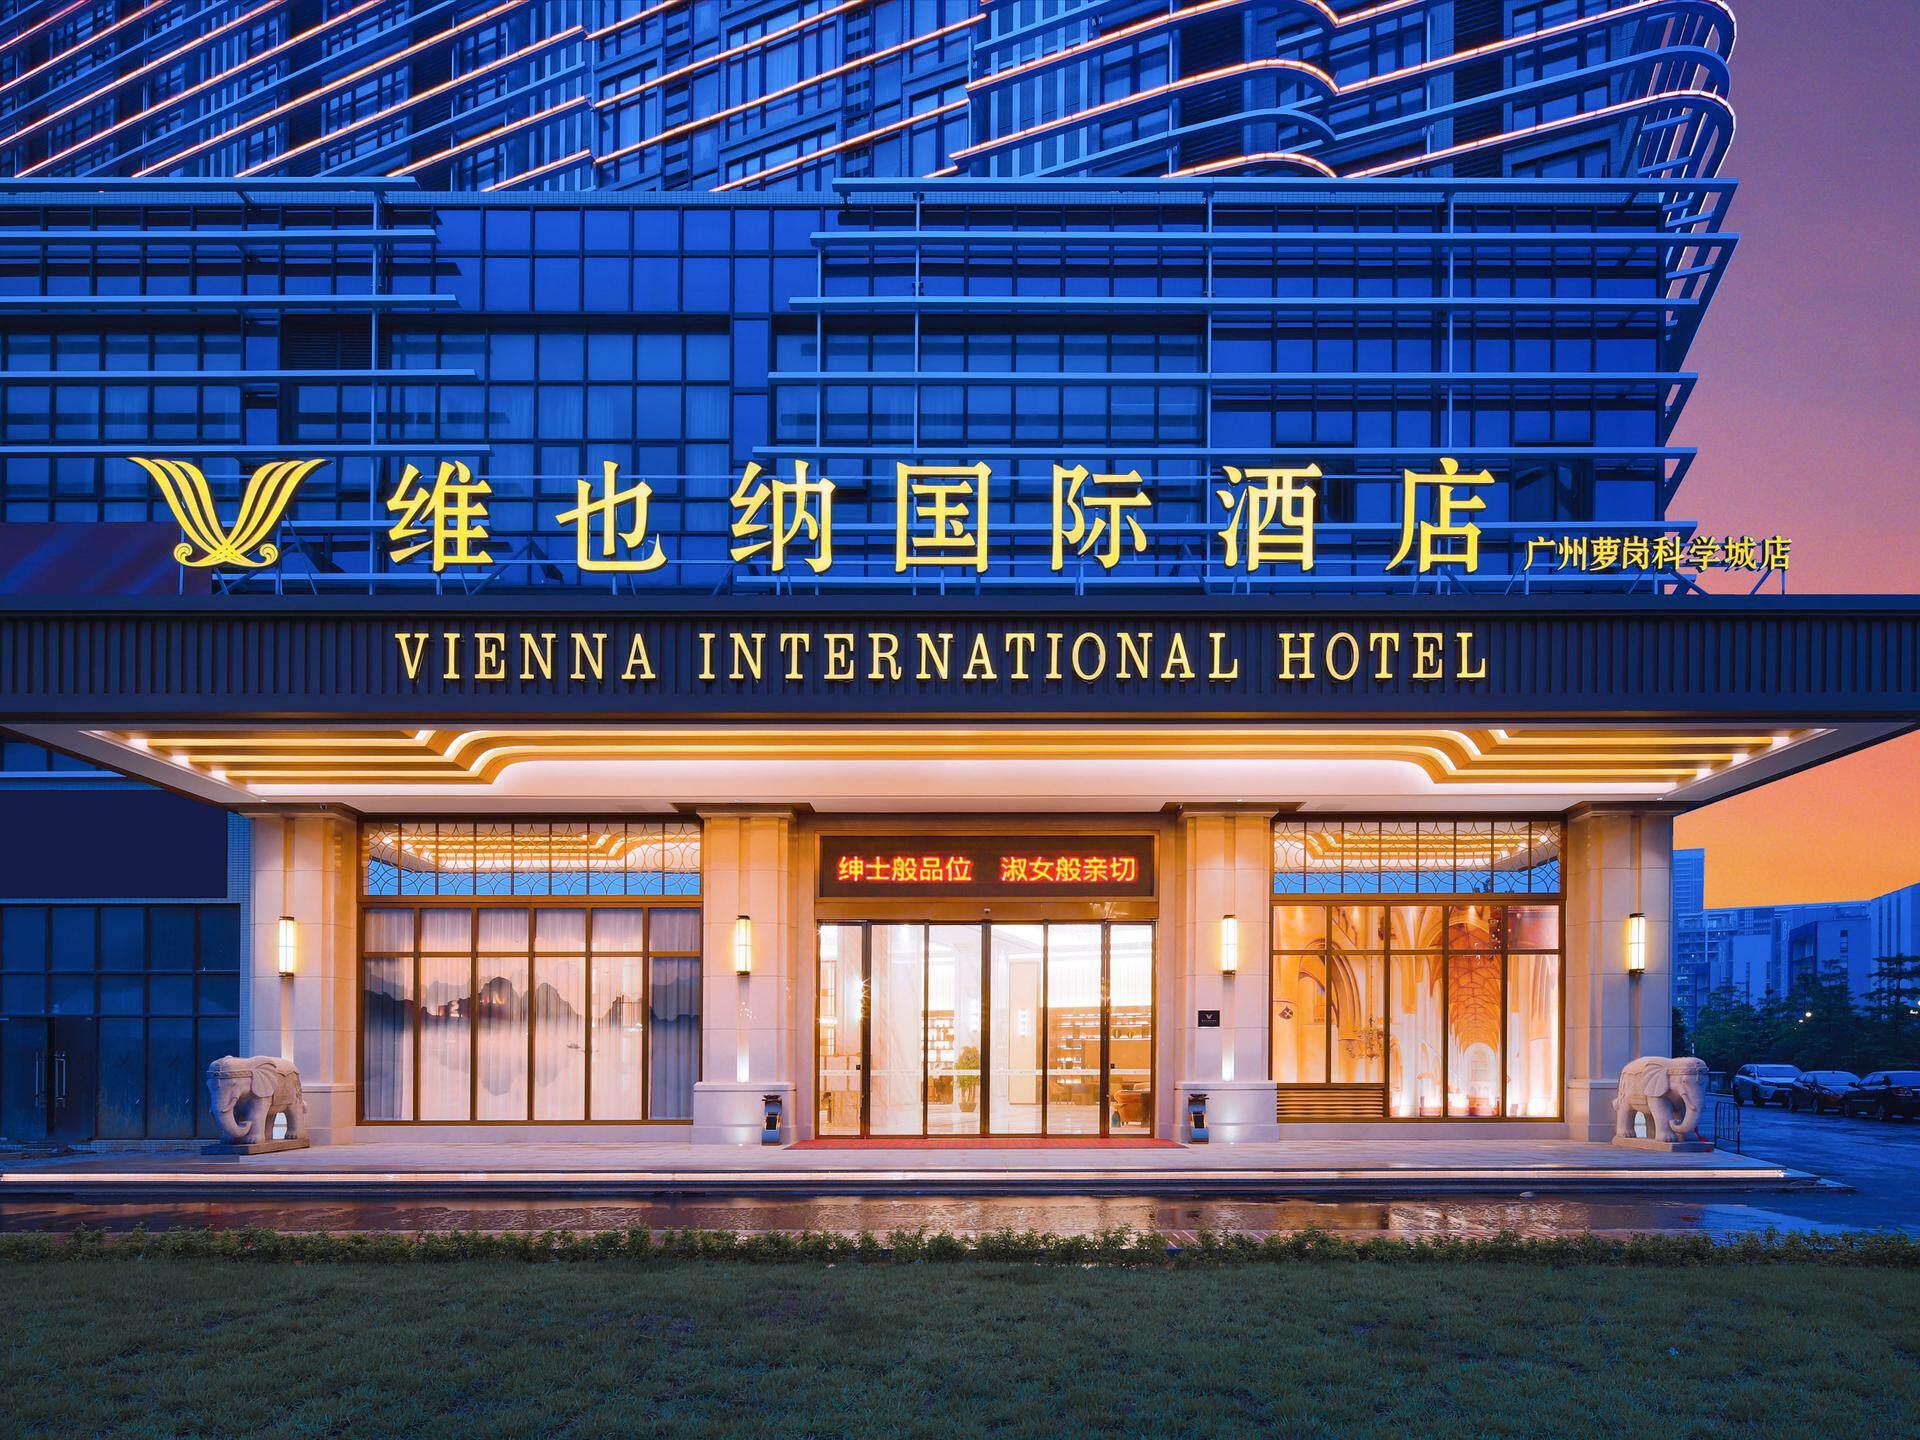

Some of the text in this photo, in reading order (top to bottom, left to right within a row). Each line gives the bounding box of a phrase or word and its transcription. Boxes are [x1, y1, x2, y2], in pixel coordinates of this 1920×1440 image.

[386, 457, 1495, 574] 维也纳国际酒店
[1523, 534, 1793, 572] 广州萝岗科学城店
[394, 632, 1487, 681] VIENNA INTERNATIONAL HOTEL
[838, 856, 1138, 882] 绅士般品位 淑女般亲切
